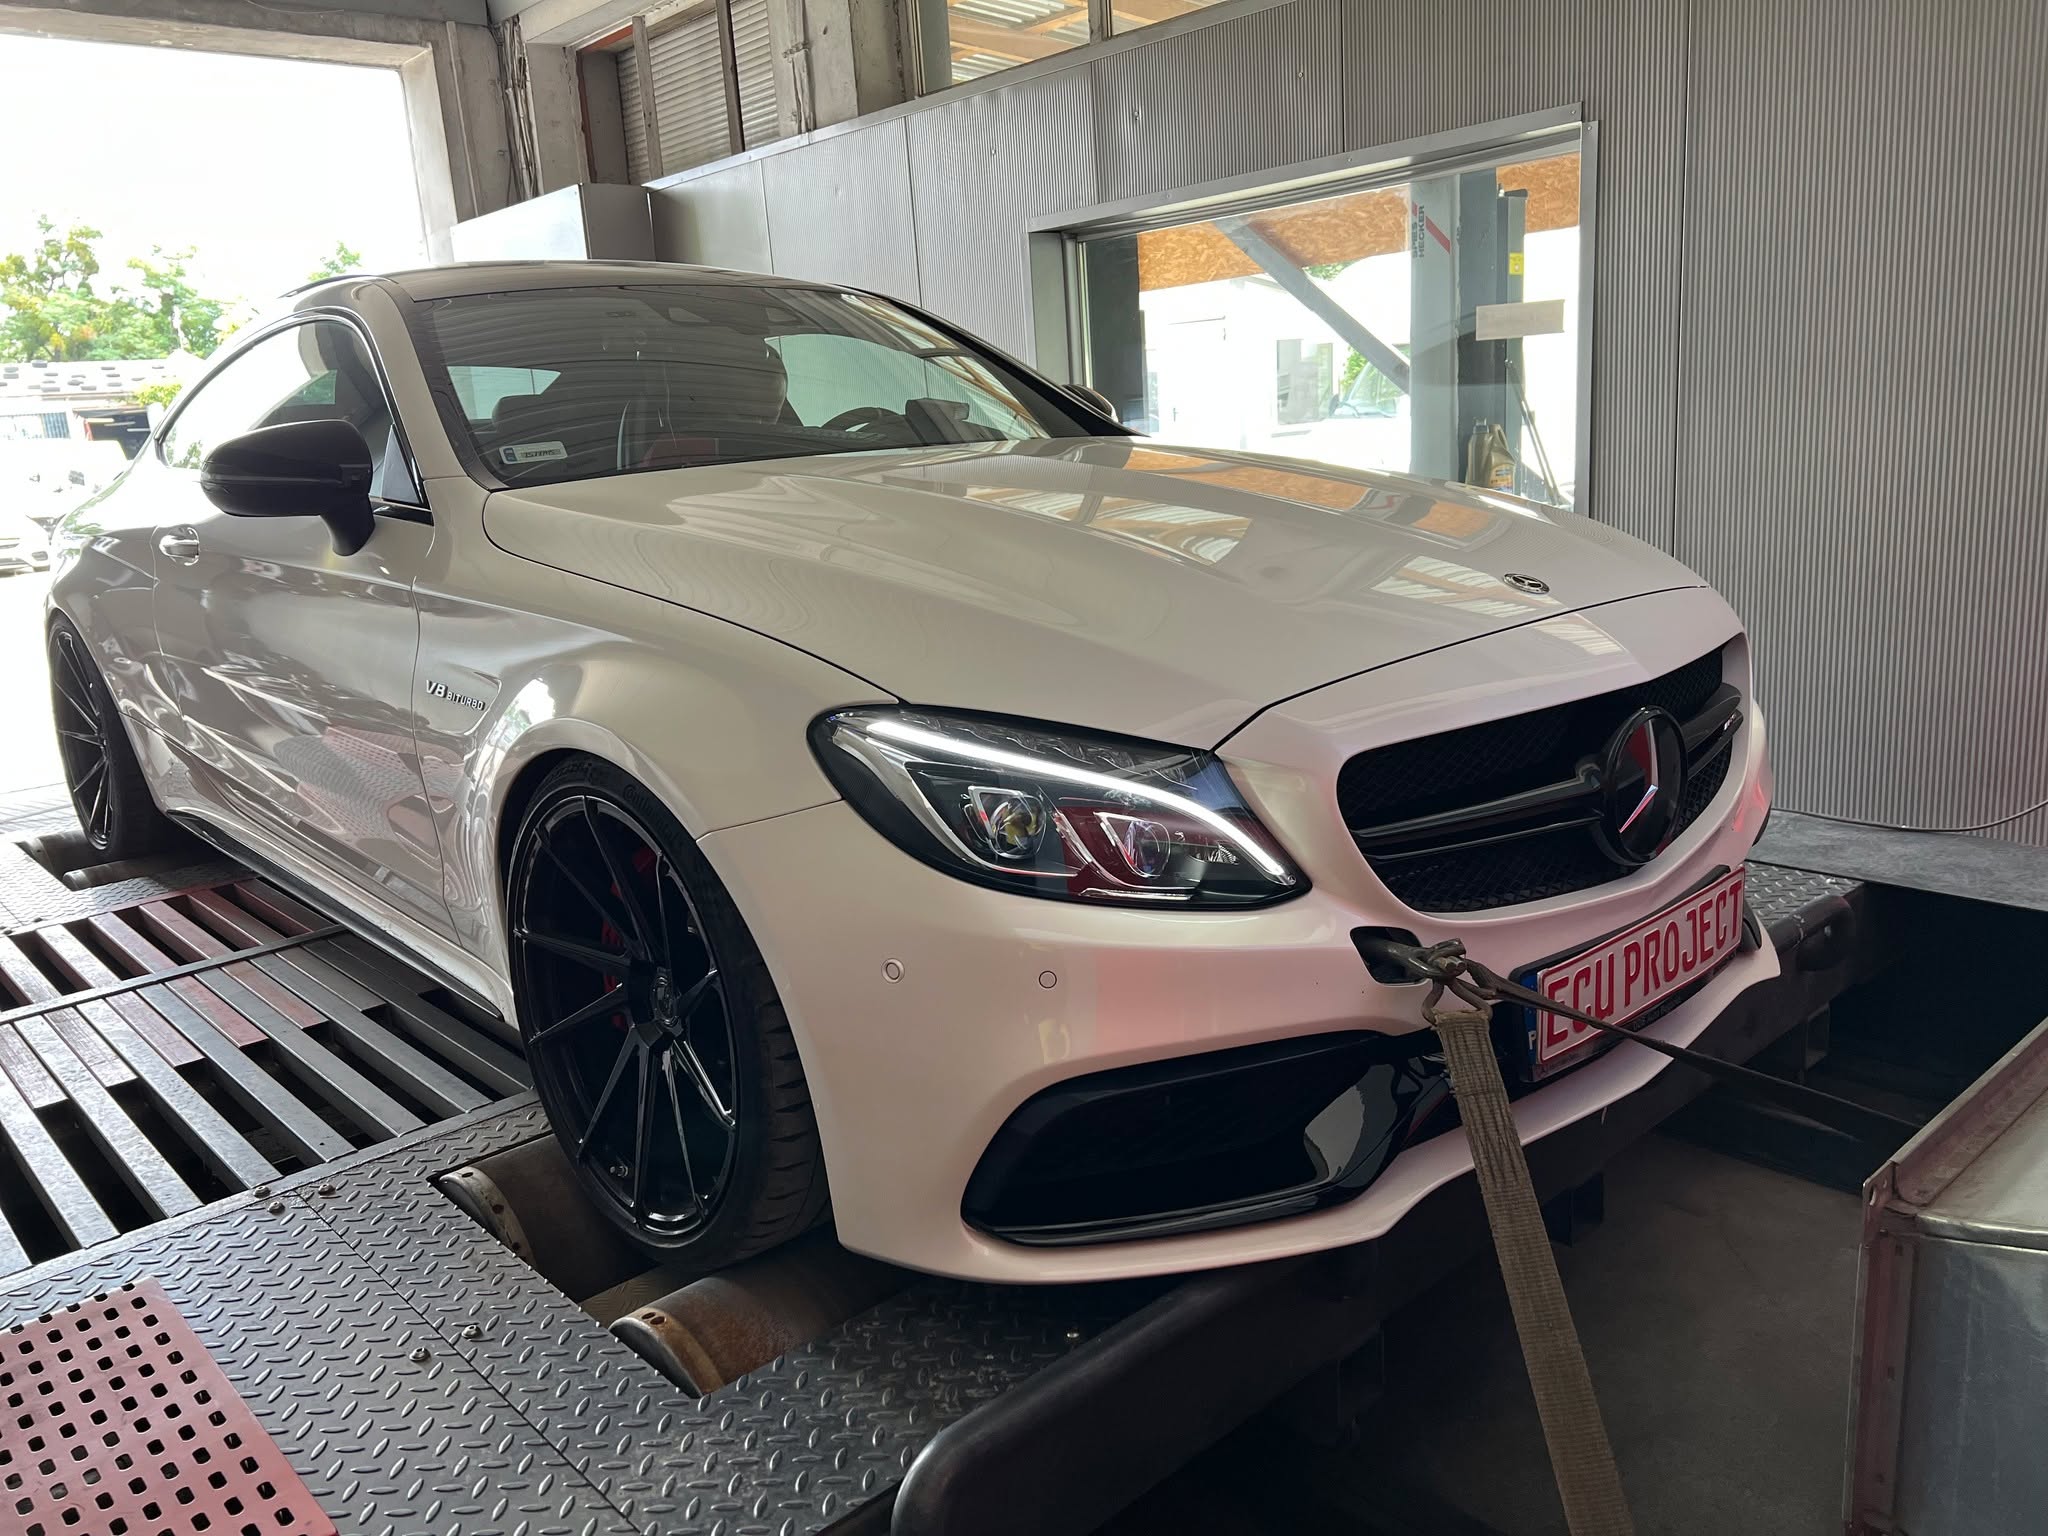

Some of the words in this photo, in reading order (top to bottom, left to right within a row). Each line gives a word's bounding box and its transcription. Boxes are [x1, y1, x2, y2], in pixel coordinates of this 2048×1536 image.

[426, 679, 448, 698] V8
[446, 691, 486, 711] BITURBO
[1547, 952, 1615, 1048] ECU
[1623, 880, 1743, 1008] PROJECT
